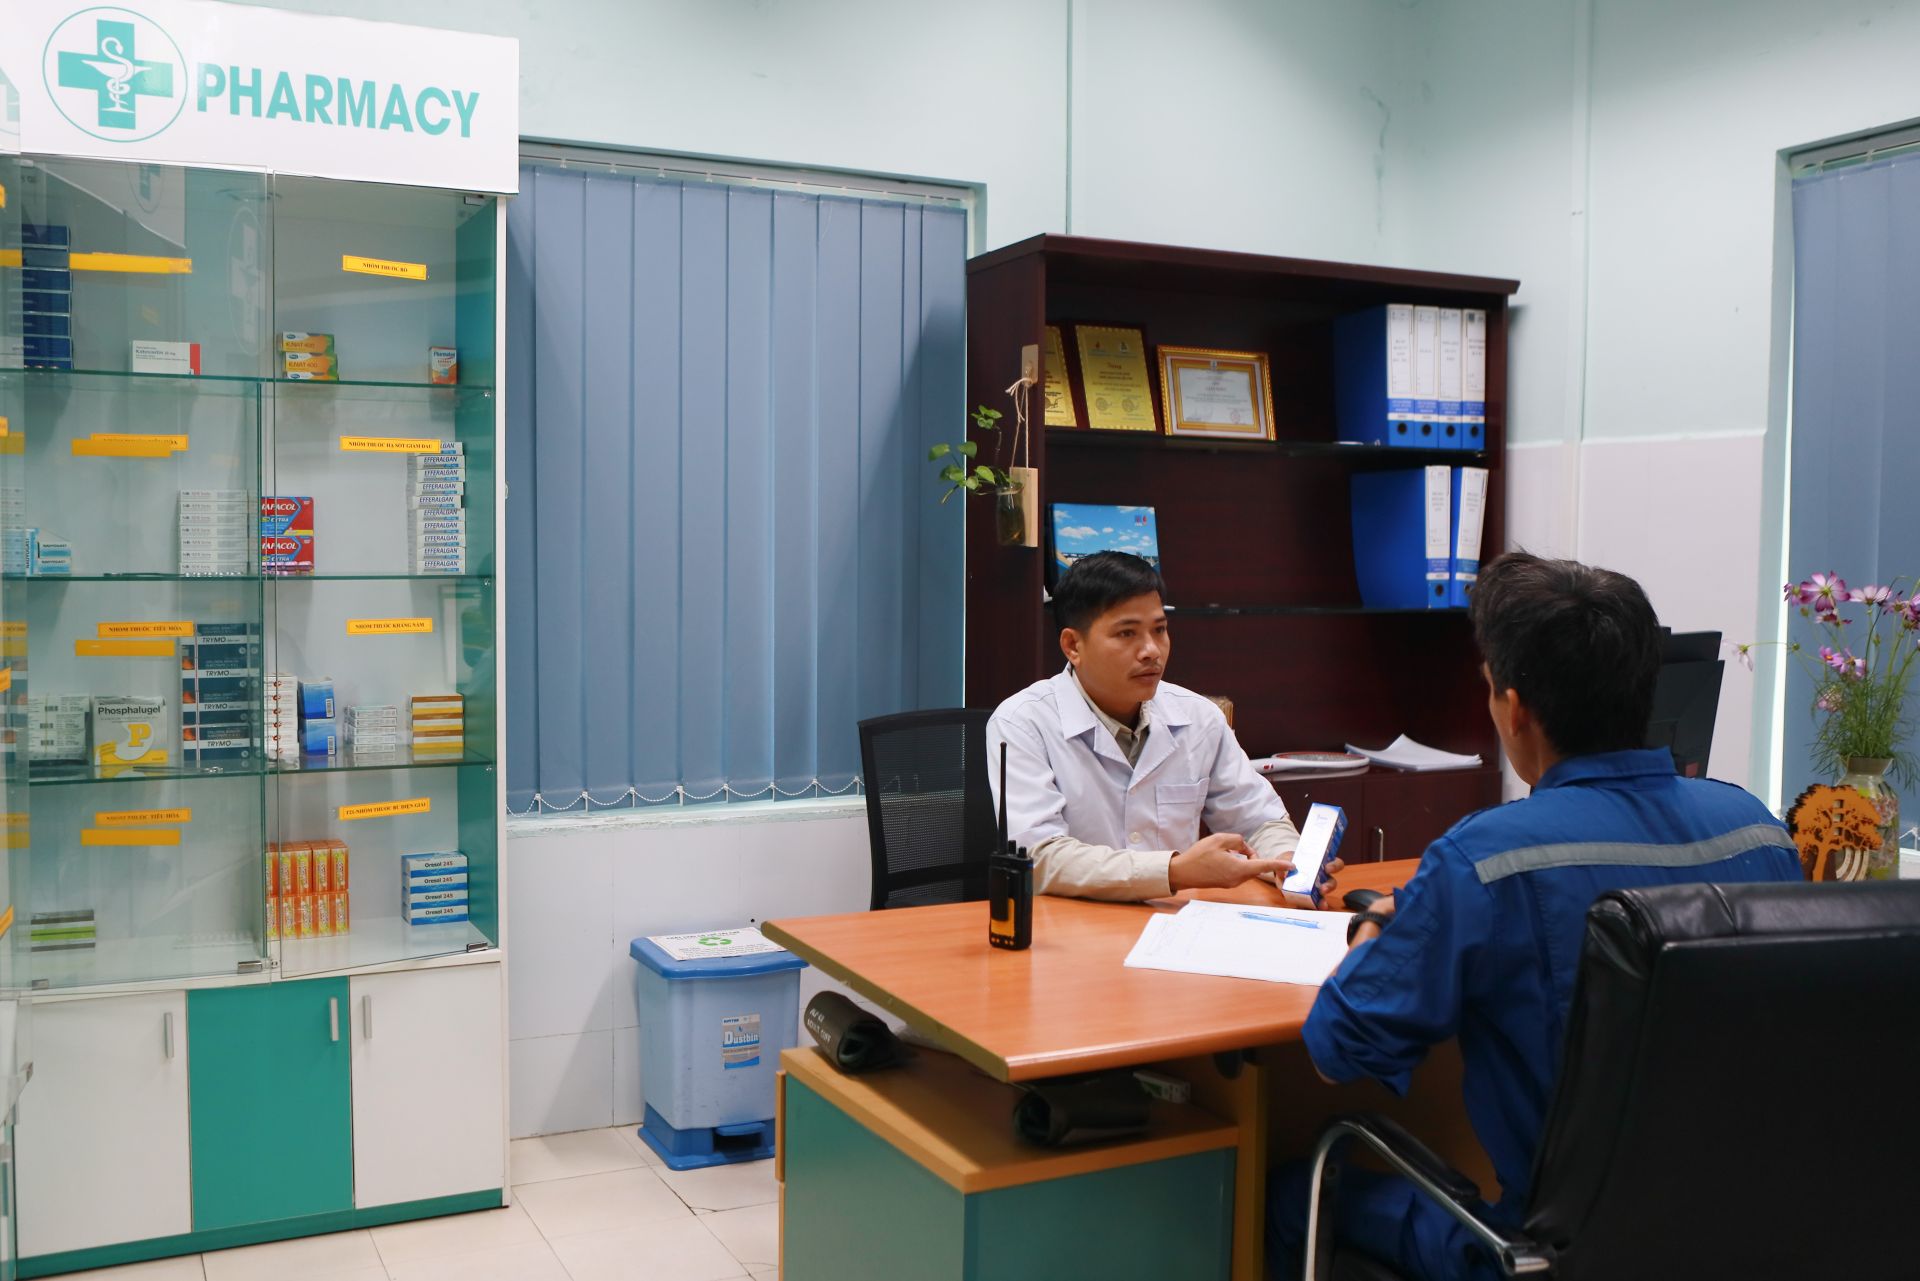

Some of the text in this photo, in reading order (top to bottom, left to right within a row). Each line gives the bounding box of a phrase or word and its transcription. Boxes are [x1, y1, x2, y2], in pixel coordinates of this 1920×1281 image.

[197, 62, 480, 138] PHARMACY
[98, 705, 161, 715] Phosphalugel
[127, 723, 152, 747] P
[724, 1031, 760, 1044] Dustbin
